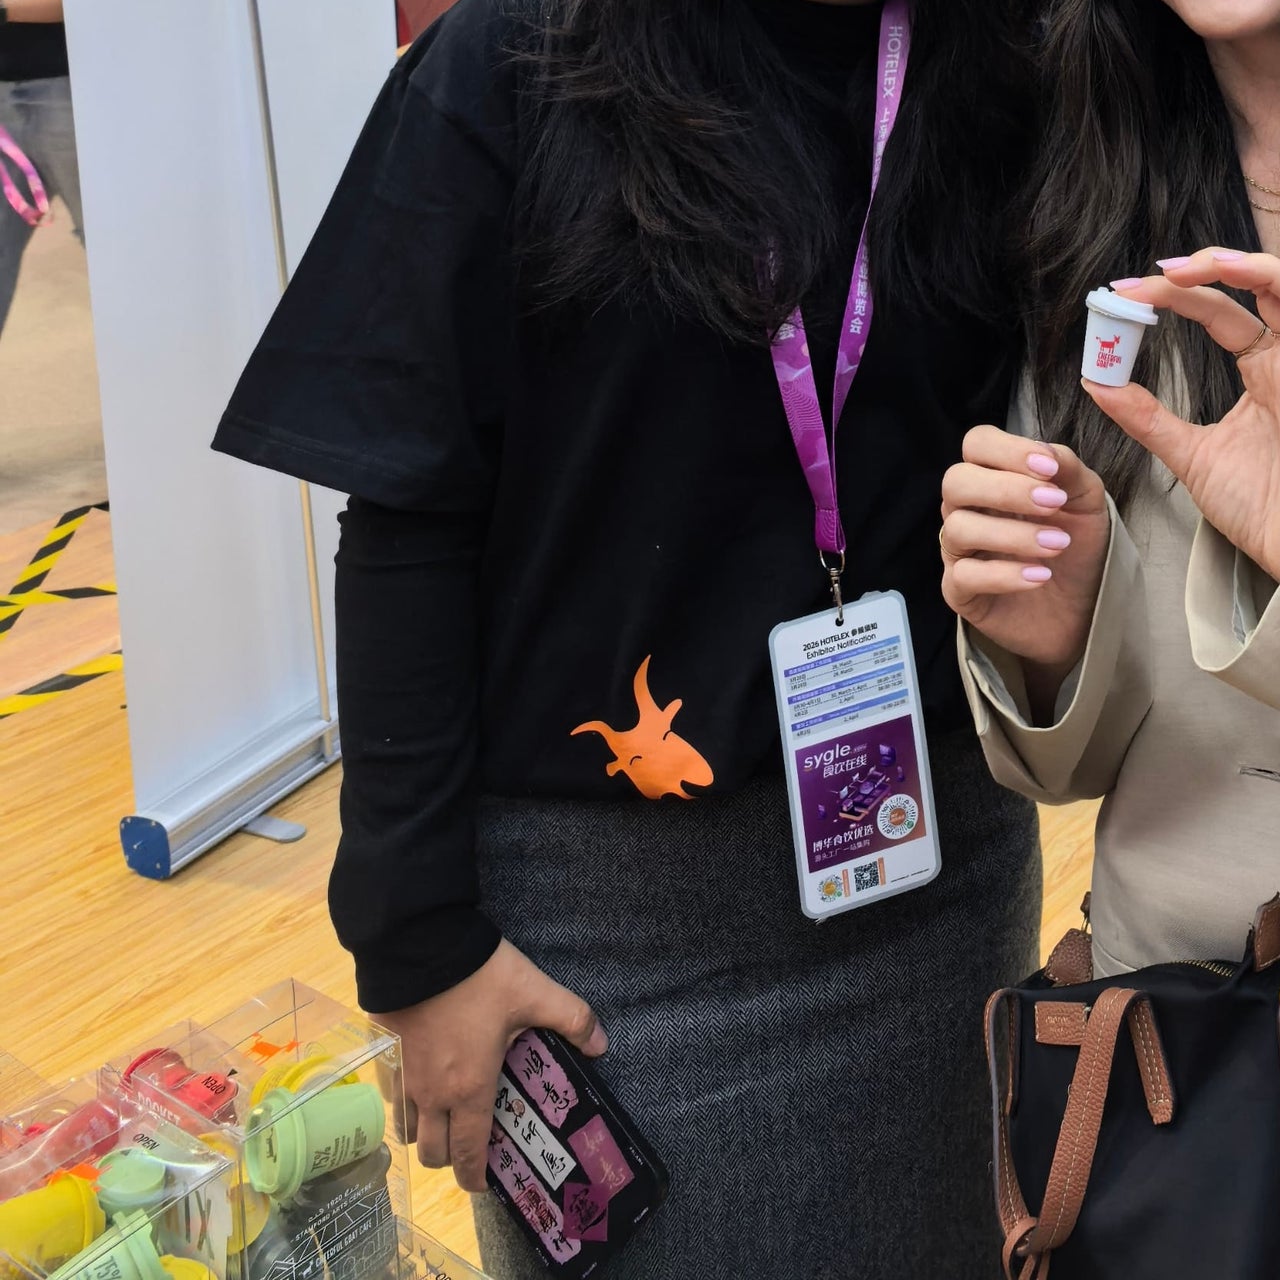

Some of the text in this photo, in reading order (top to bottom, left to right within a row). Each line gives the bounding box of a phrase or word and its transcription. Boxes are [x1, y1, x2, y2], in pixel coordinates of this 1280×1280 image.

[883, 25, 903, 99] HOTELEX
[1098, 351, 1122, 365] CHEERFUL
[802, 641, 820, 652] 2026
[819, 631, 850, 647] HOTELEX
[806, 633, 877, 660] Exhibitor Notification
[803, 742, 851, 770] sygle
[822, 753, 868, 778] 食饮在线
[812, 825, 874, 853] 博华食饮优选
[201, 1074, 226, 1096] OPEN
[132, 1133, 160, 1152] OPEN
[310, 1145, 333, 1174] 75%
